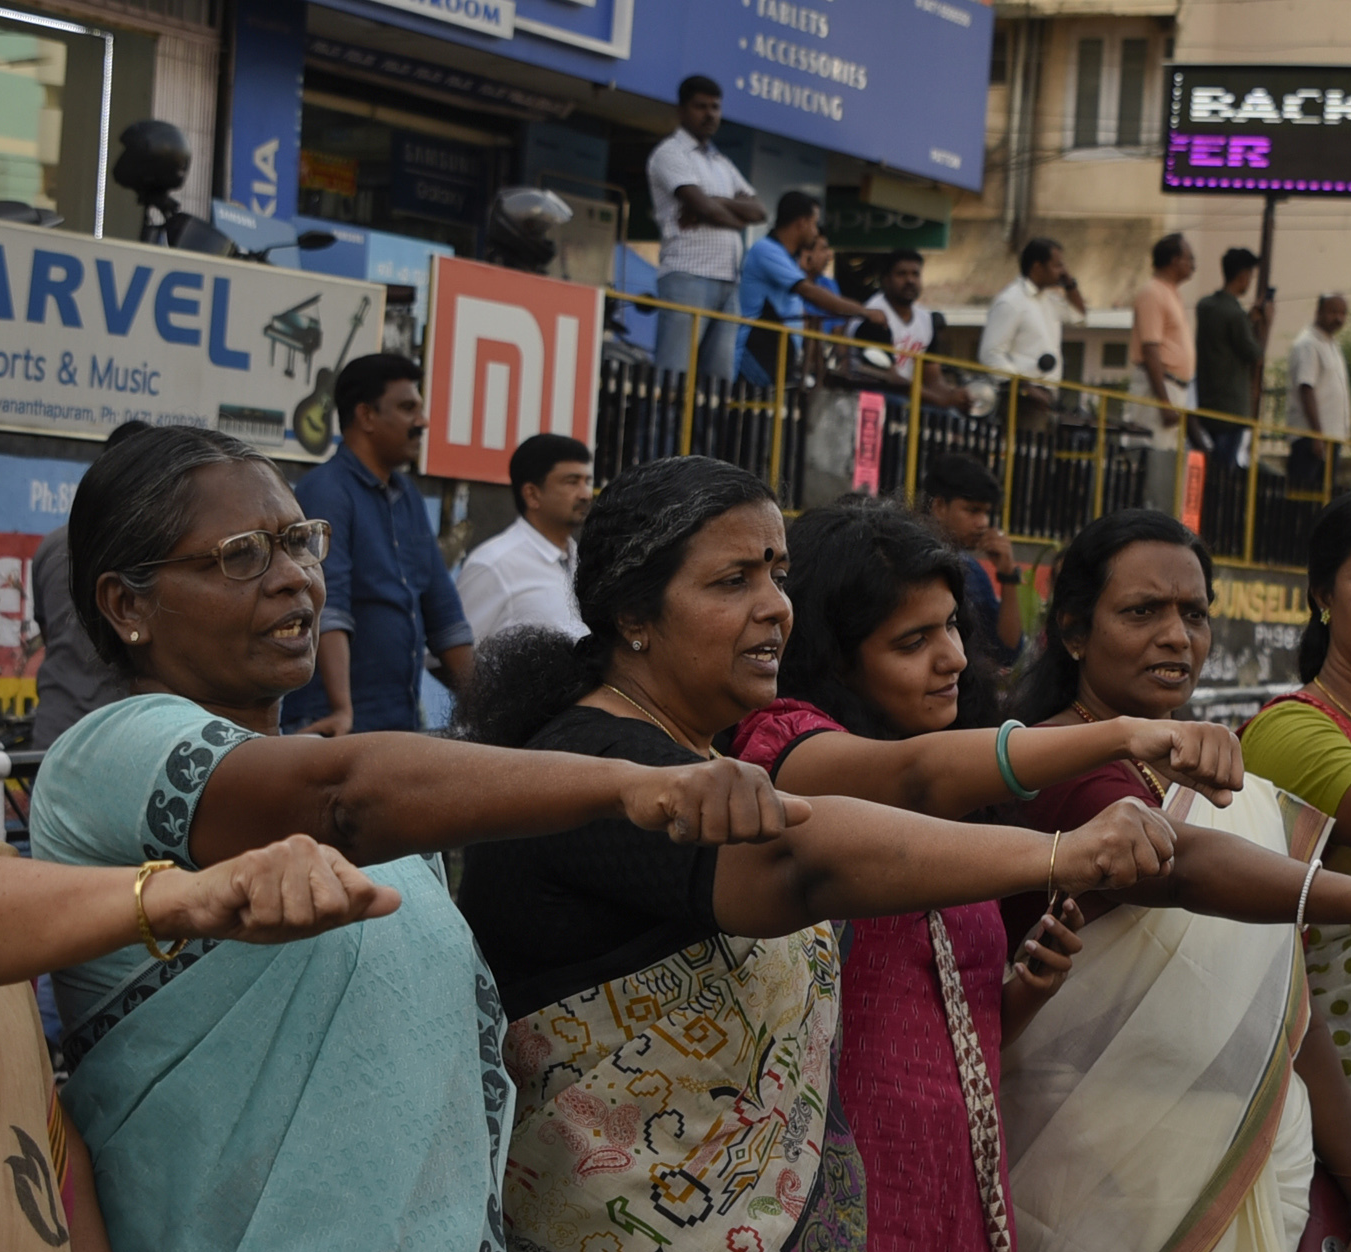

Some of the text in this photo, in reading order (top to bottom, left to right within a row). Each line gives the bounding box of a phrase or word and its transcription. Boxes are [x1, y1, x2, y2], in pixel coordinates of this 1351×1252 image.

[754, 34, 868, 91] ACCESSORIES
[749, 72, 844, 122] SERVICING
[57, 351, 78, 387] &
[89, 354, 161, 397] Music
[100, 404, 122, 425] Ph:
